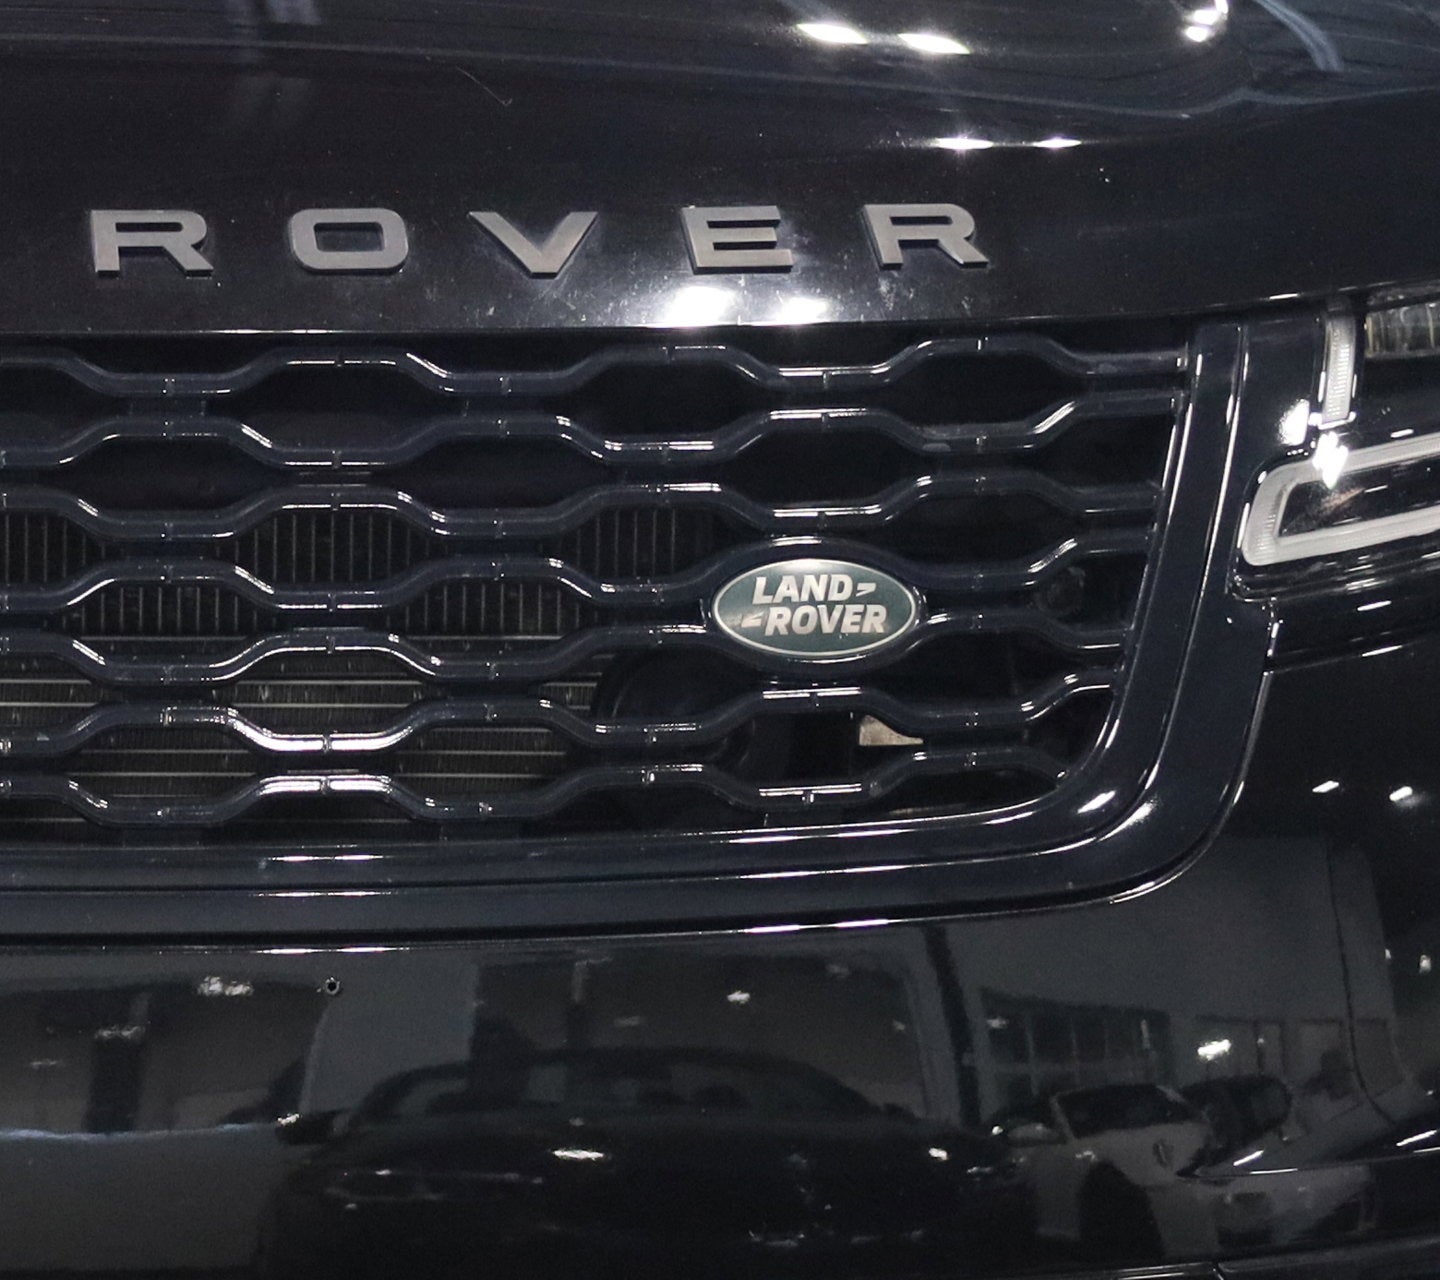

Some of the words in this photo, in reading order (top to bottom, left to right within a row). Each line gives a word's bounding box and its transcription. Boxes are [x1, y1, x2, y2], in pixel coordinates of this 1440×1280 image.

[90, 203, 989, 278] ROVER
[752, 574, 853, 604] LAND
[765, 604, 887, 636] ROVER
